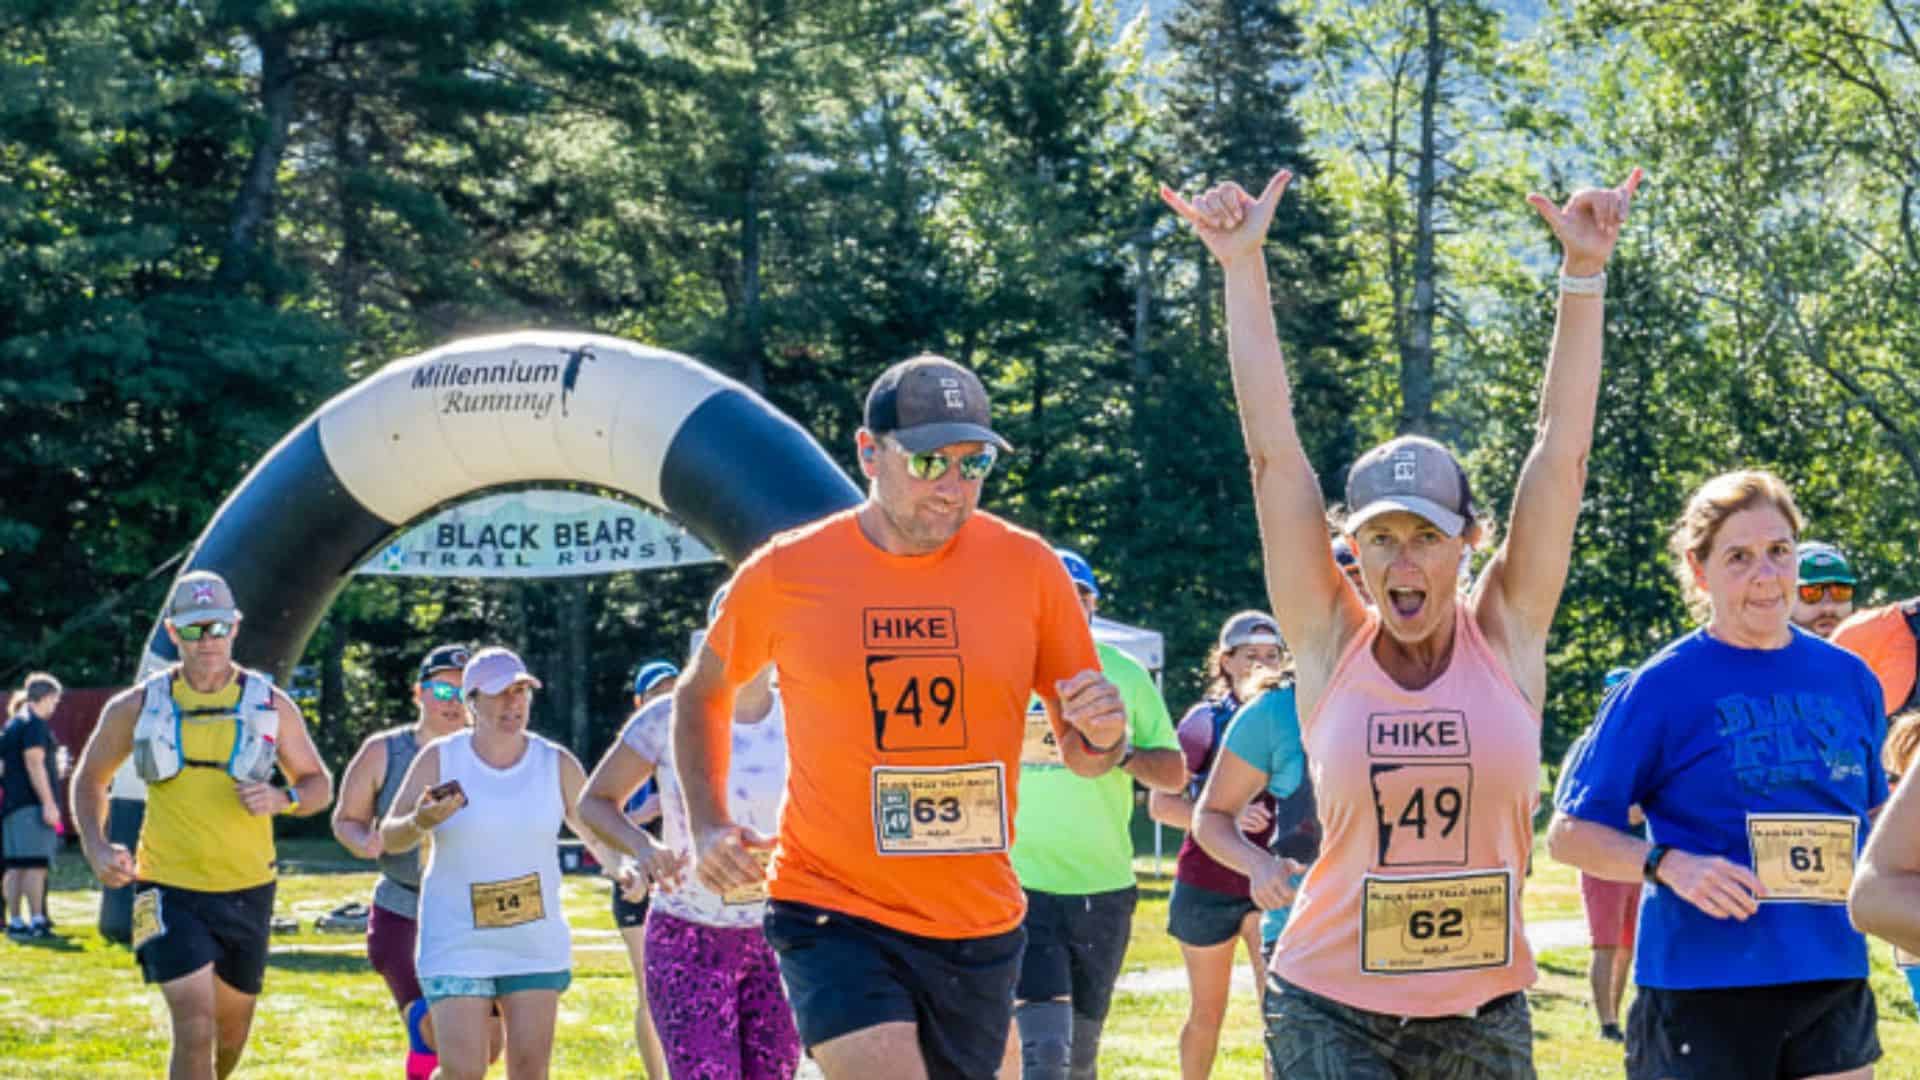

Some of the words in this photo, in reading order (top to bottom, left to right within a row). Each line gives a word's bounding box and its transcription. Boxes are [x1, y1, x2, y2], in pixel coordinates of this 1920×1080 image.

[411, 358, 558, 389] Millennium
[441, 391, 555, 419] Running
[437, 523, 541, 550] BLACK
[554, 517, 636, 548] BEAR
[417, 551, 532, 567] TRAIL
[557, 542, 656, 566] RUNS
[872, 617, 947, 639] HIKE
[894, 676, 956, 728] 49
[1377, 720, 1459, 747] HIKE
[913, 797, 962, 823] 63
[1398, 786, 1462, 839] 49
[1791, 846, 1825, 872] 61
[497, 894, 520, 911] 14
[1409, 908, 1463, 939] 62
